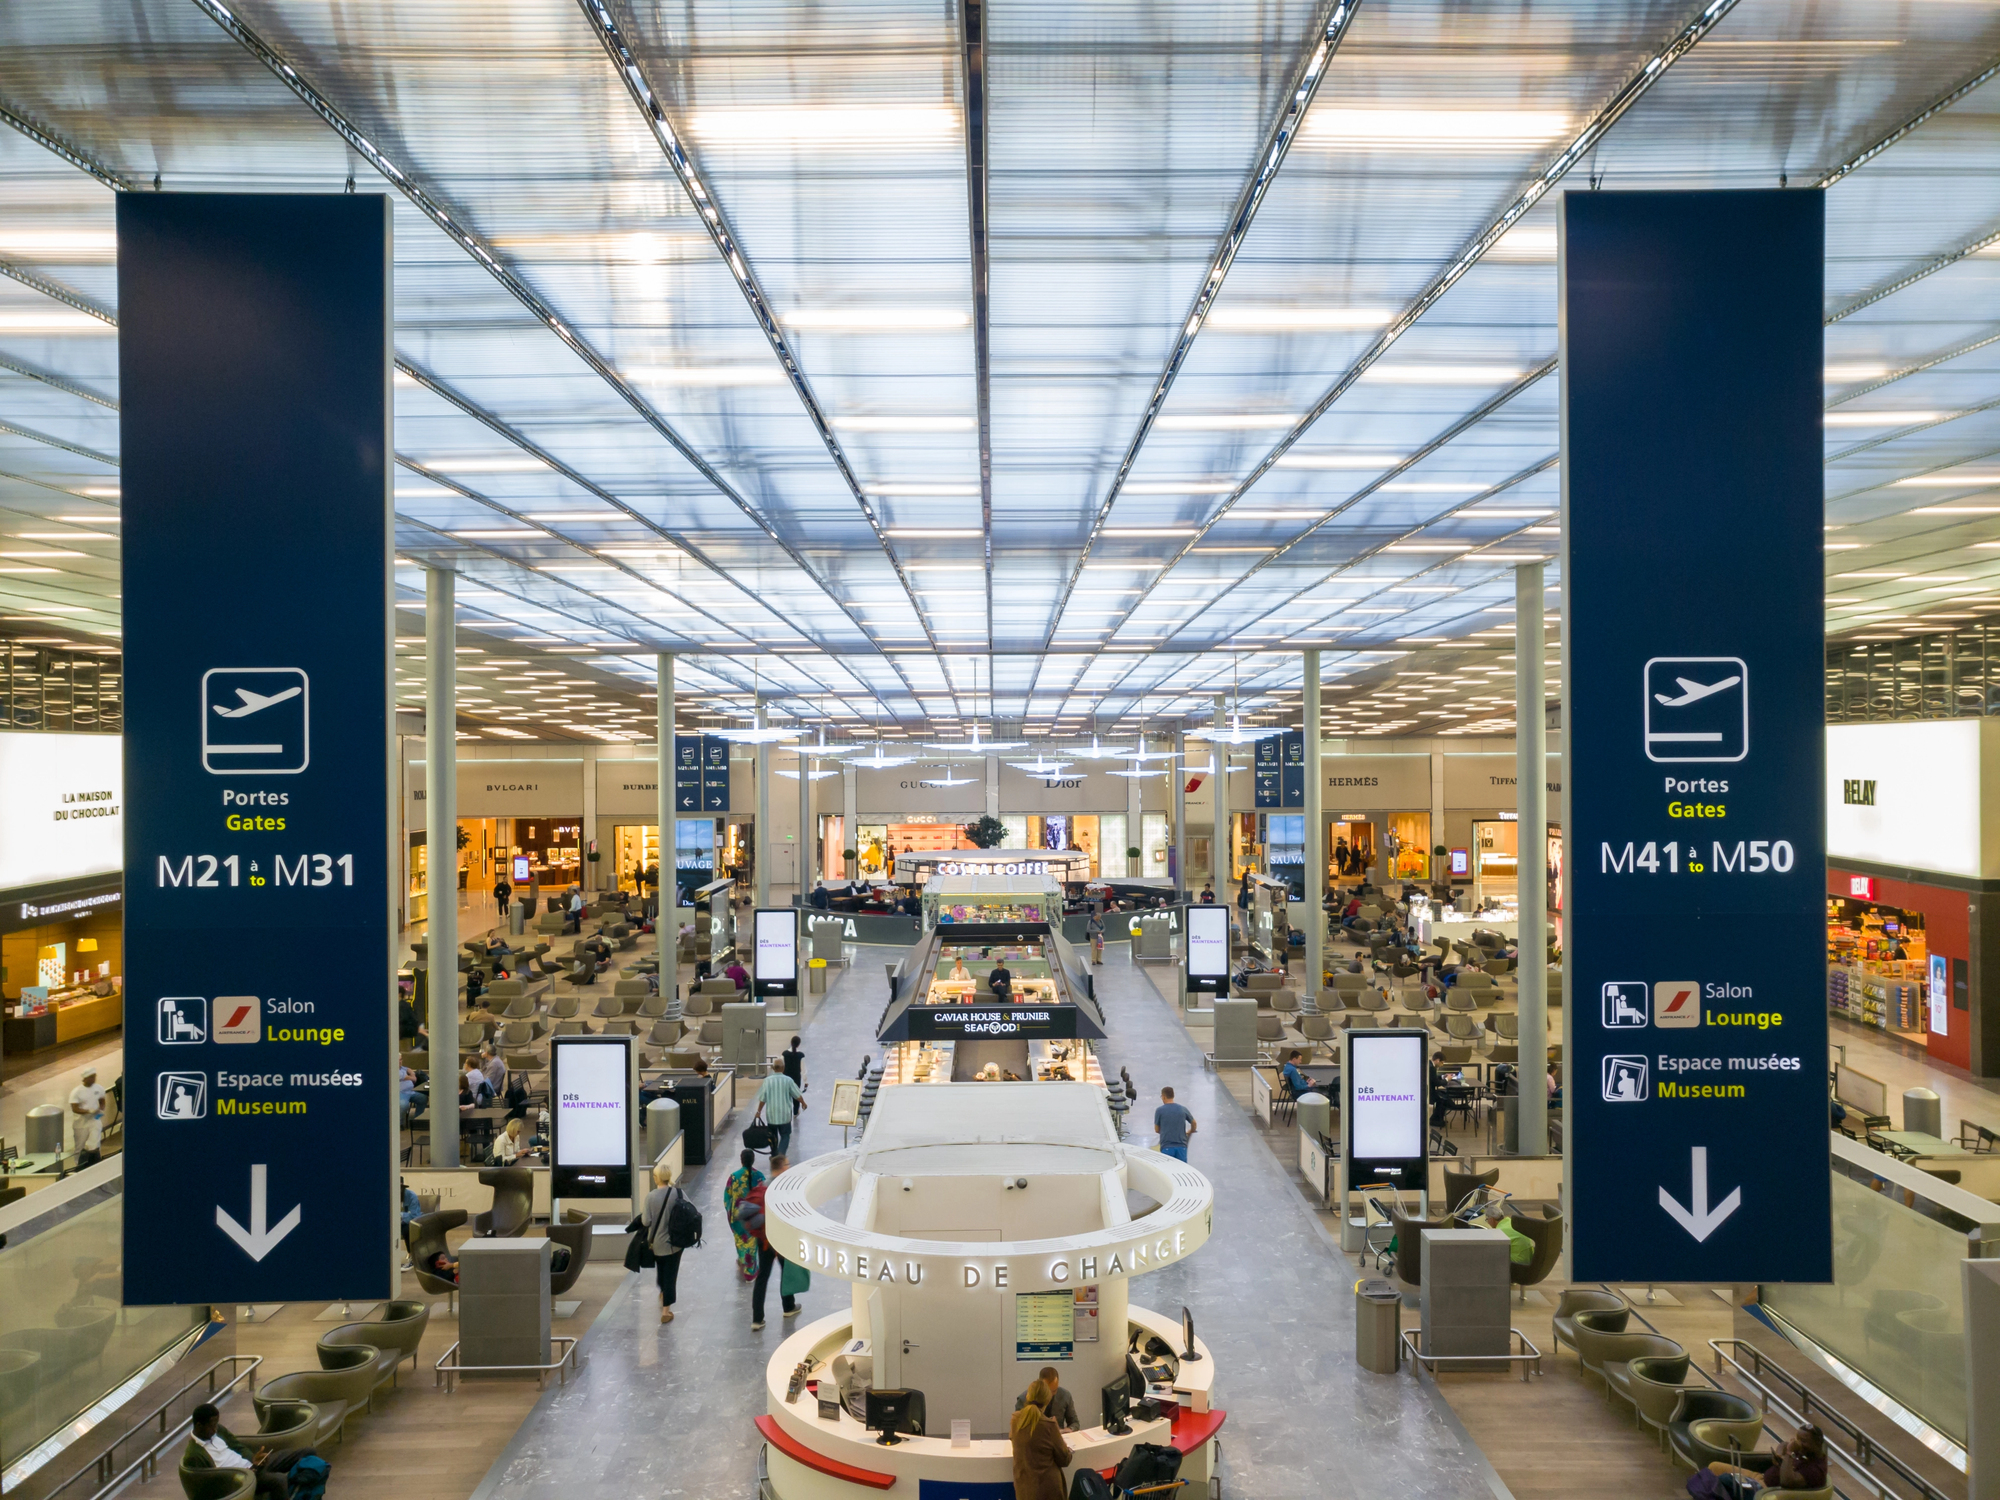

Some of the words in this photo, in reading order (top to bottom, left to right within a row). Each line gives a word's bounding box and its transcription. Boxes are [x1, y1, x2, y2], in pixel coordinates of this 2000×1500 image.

[1664, 777, 1729, 793] Portes
[1843, 779, 1877, 806] RELAY
[62, 793, 75, 803] LA
[77, 790, 112, 802] MAISON
[223, 789, 289, 806] Portes
[53, 810, 69, 821] DU
[70, 806, 119, 819] CHOCOLAT
[1668, 802, 1726, 818] Gates
[226, 814, 286, 831] Gates
[906, 815, 937, 823] GUCCI
[1601, 842, 1678, 873] M41
[1689, 847, 1697, 858] à
[1713, 841, 1794, 872] M50
[159, 855, 239, 887] M21
[250, 861, 259, 872] à
[275, 854, 353, 886] M31
[937, 862, 989, 876] COSTA
[994, 862, 1048, 875] COFFEE
[1689, 862, 1704, 873] to
[250, 875, 265, 886] to
[1706, 983, 1752, 998] Salon
[267, 998, 315, 1013] Salon
[934, 1013, 968, 1022] CAVIAR
[970, 1013, 1001, 1021] HOUSE
[1011, 1012, 1050, 1021] PRUNIER
[1706, 1010, 1783, 1030] Lounge
[267, 1025, 345, 1045] Lounge
[1658, 1055, 1722, 1074] Espace
[1728, 1053, 1800, 1070] musées
[217, 1071, 284, 1091] Espace
[290, 1069, 363, 1086] musées
[563, 1093, 579, 1101] DÈS
[1358, 1086, 1374, 1094] DÈS
[1658, 1082, 1745, 1097] Museum
[562, 1101, 621, 1109] MAINTENANT.
[1357, 1094, 1416, 1102] MAINTENANT.
[217, 1099, 307, 1115] Museum
[798, 1239, 922, 1285] BUREAU
[963, 1264, 1008, 1288] DE
[1048, 1230, 1186, 1284] CHANGE
